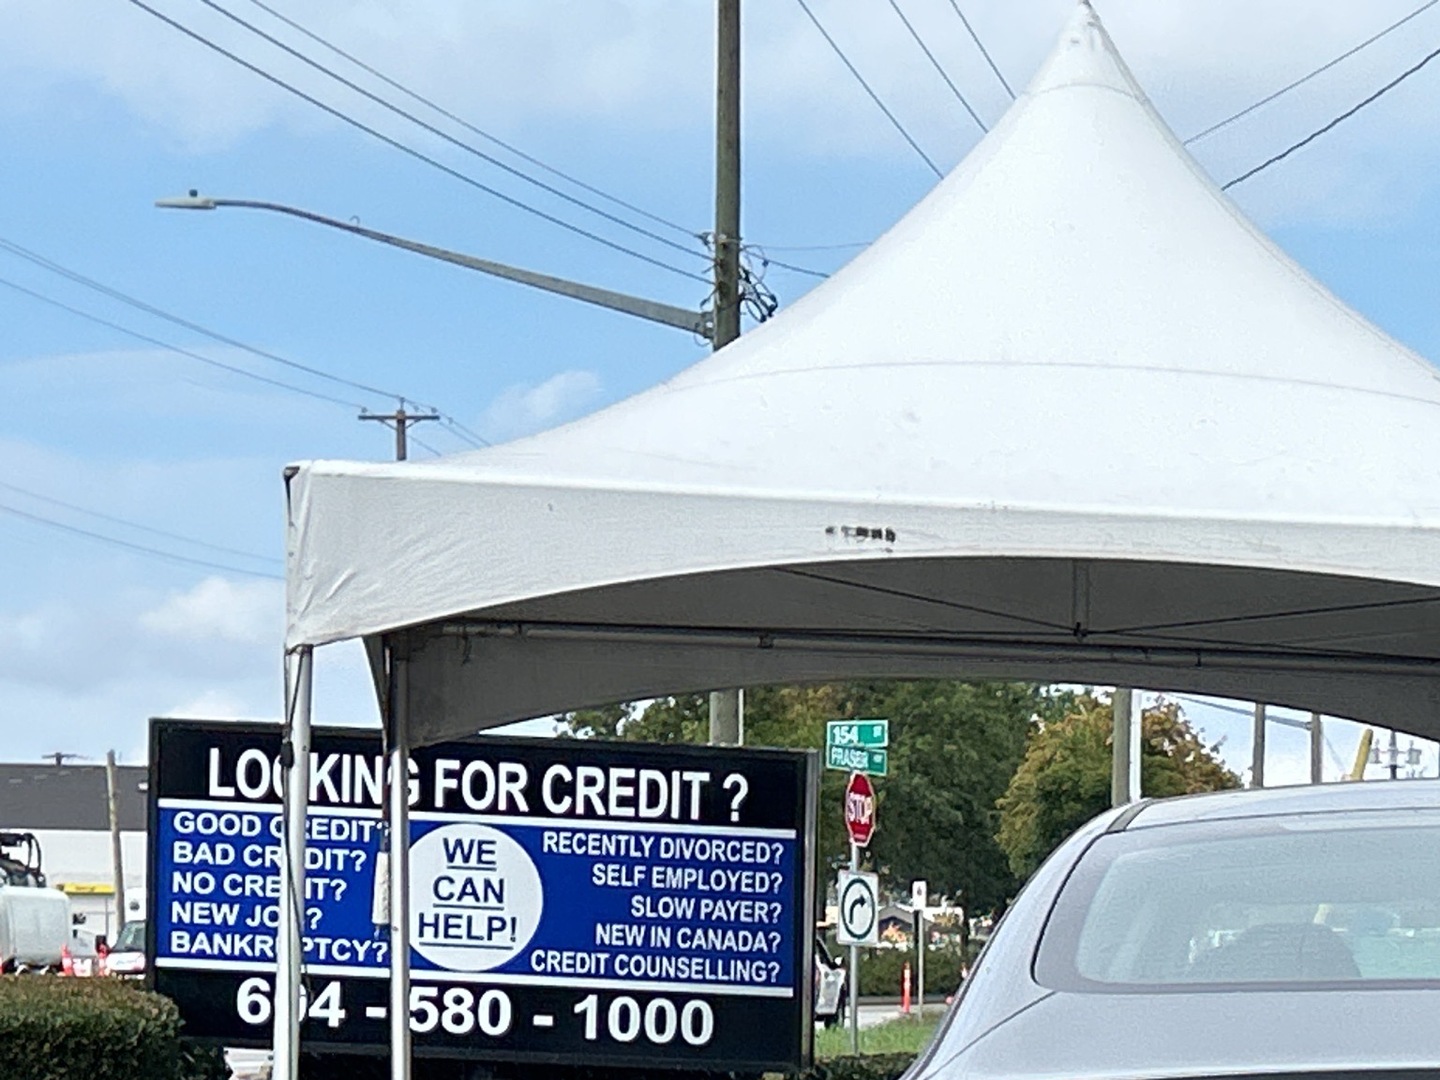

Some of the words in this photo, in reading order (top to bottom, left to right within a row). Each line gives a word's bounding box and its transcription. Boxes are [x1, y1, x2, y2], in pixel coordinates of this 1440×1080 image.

[833, 725, 859, 744] 154
[209, 747, 420, 806] LOKING
[434, 758, 529, 813] FOR
[542, 763, 711, 821] CREDIT
[723, 773, 748, 823] ?
[847, 791, 873, 824] STOP
[173, 811, 262, 838] GOOD
[269, 815, 391, 844] CEDIT?
[172, 840, 236, 865] BAD
[243, 846, 367, 873] CRDIT?
[443, 837, 497, 865] WE
[543, 830, 654, 858] RECENTLY
[659, 836, 784, 865] DIVORCED?
[171, 870, 216, 895] NO
[222, 872, 347, 902] CREIT?
[433, 874, 505, 904] CAN
[592, 862, 647, 887] SELF
[651, 866, 783, 895] EMPLOYED?
[170, 901, 240, 926] NEW
[245, 904, 323, 930] JO?
[631, 894, 696, 919] SLOW
[699, 898, 782, 924] PAYER?
[418, 912, 518, 943] HELP!
[595, 922, 646, 948] NEW
[650, 925, 671, 948] IN
[676, 927, 782, 954] CANADA?
[170, 930, 388, 963] BANKRPTCY?
[530, 949, 610, 975] CREDIT
[614, 953, 780, 983] COUNSELLING?
[236, 977, 346, 1028] 64
[407, 986, 512, 1036] 580
[573, 993, 714, 1046] 1000
